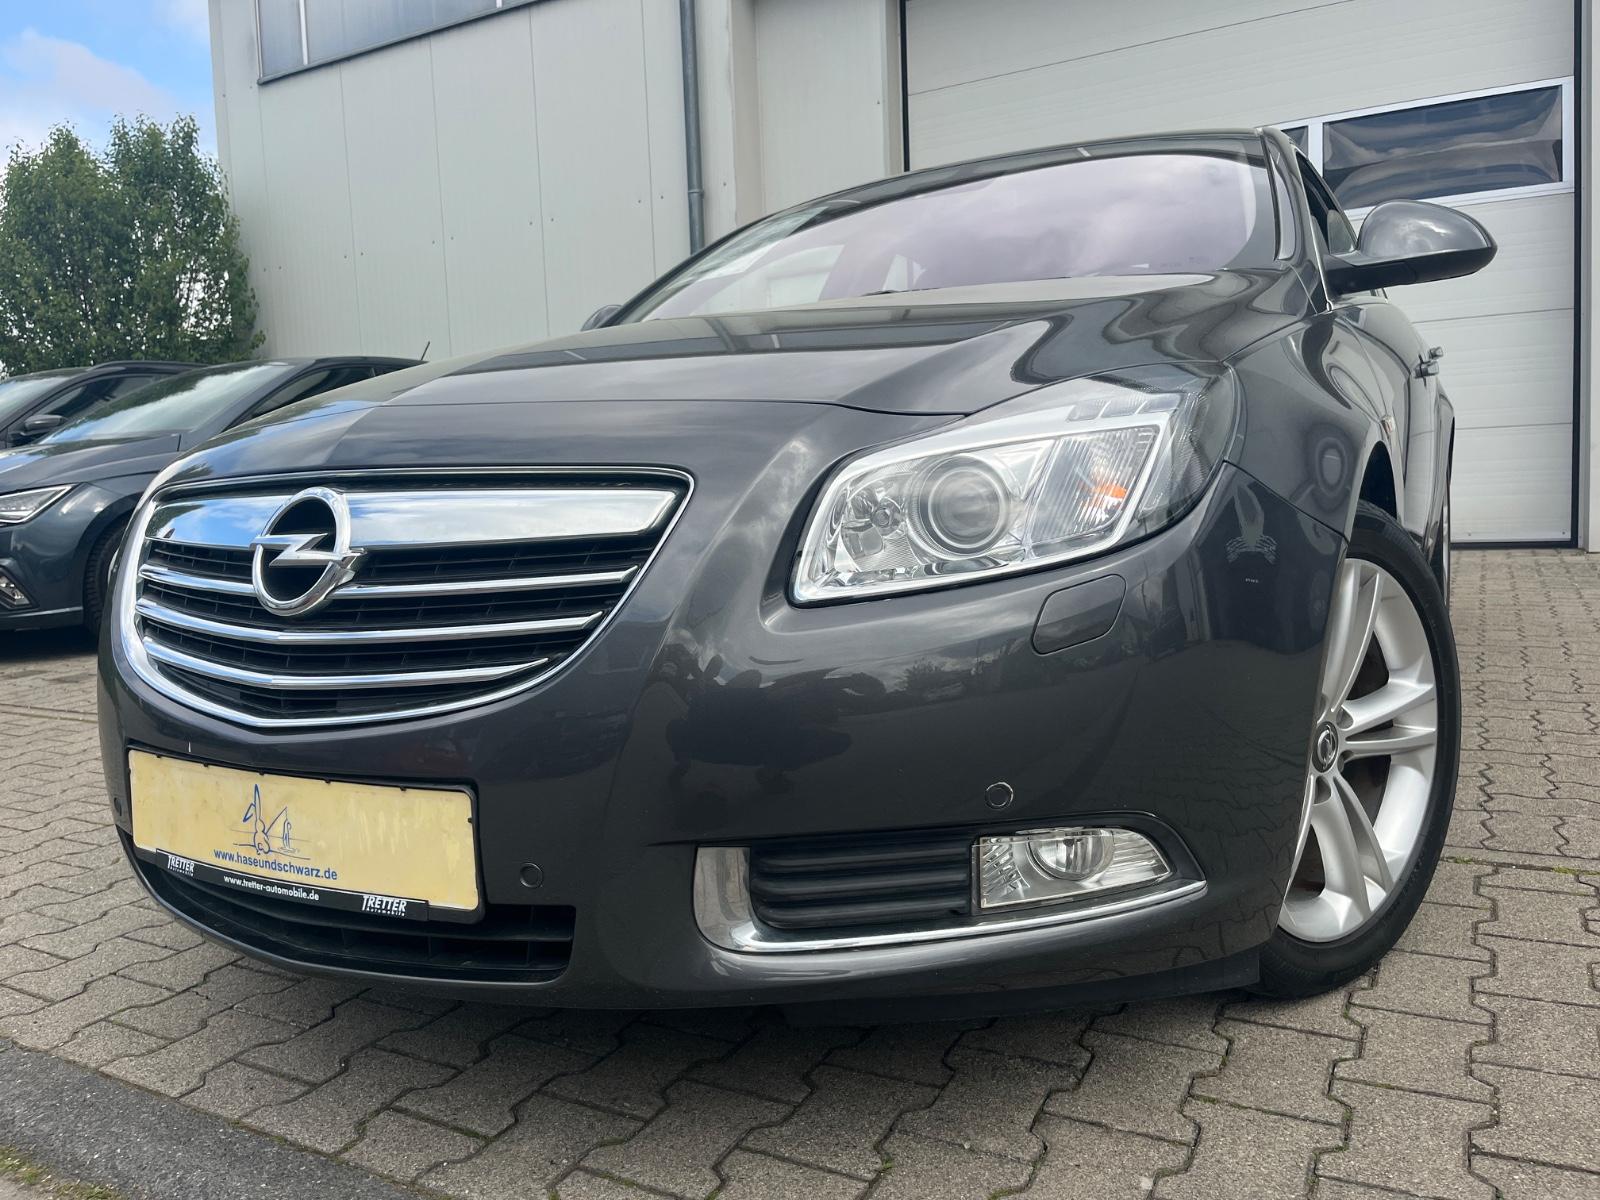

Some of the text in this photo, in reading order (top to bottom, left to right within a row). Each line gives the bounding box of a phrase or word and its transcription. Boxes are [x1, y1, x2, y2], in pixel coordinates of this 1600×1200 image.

[167, 855, 195, 872] TRETTER
[213, 849, 338, 880] www.haseundschwarz.de
[223, 875, 320, 901] www.tretter-automobile.de
[362, 895, 407, 912] TRETTER
